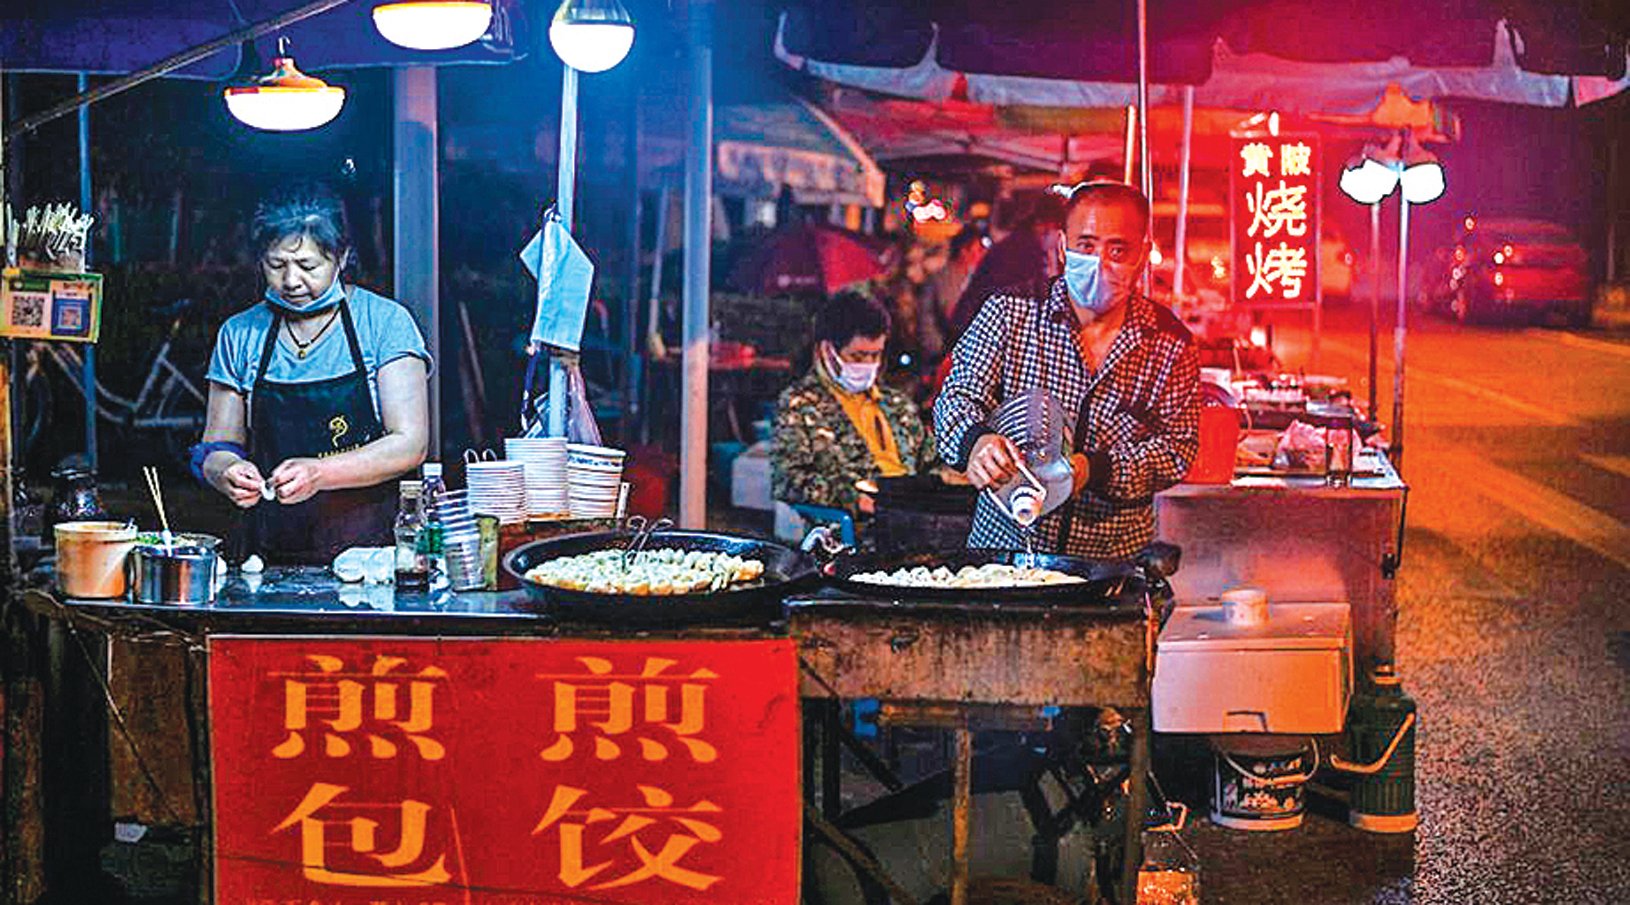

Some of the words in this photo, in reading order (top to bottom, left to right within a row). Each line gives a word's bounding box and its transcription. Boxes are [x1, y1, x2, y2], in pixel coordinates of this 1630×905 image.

[1246, 180, 1307, 298] 烧烤
[268, 655, 451, 886] 煎包
[532, 657, 723, 891] 煎饺
